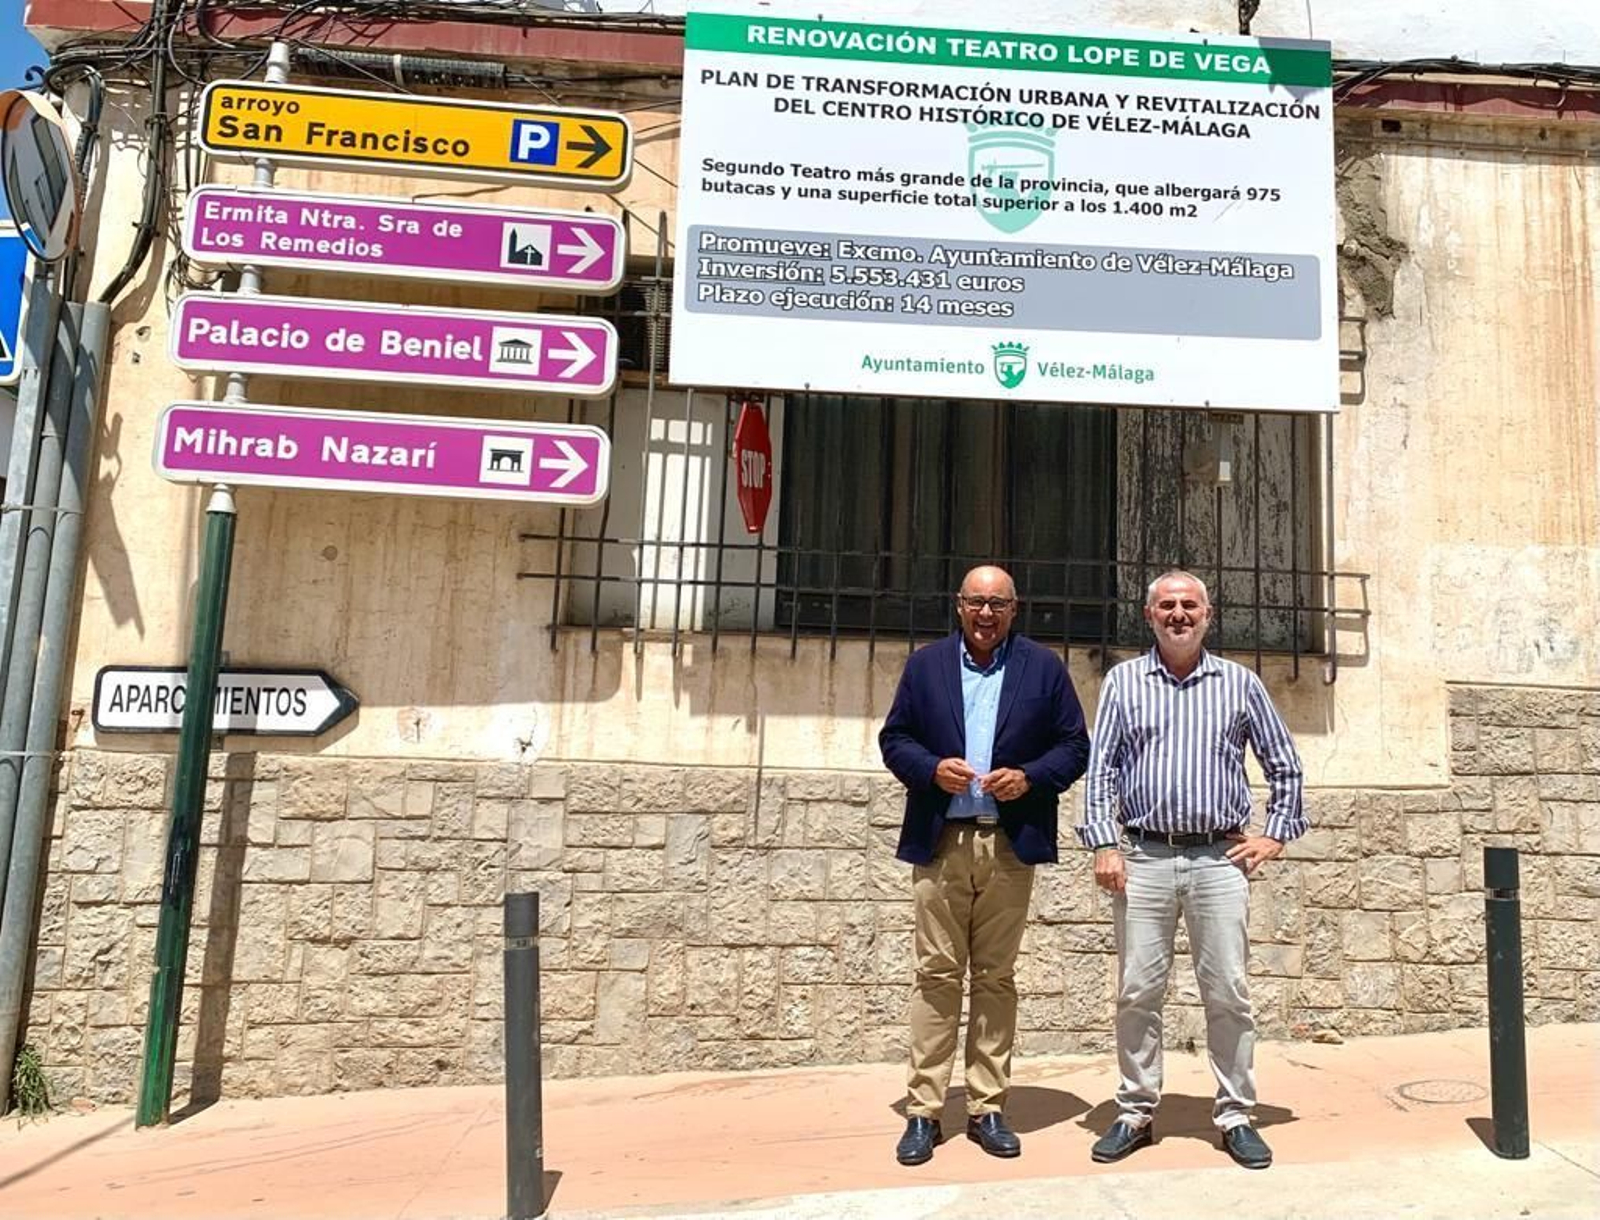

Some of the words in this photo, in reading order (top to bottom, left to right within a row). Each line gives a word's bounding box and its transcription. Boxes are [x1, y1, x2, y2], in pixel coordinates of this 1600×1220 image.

[747, 25, 936, 55] RENOVACIÓN
[946, 37, 1058, 62] TEATRO
[1067, 45, 1139, 66] LOPE
[1149, 50, 1185, 69] DE
[1194, 53, 1271, 74] VEGA
[220, 95, 301, 116] arroyo
[700, 69, 758, 88] PLAN
[766, 74, 795, 90] DE
[802, 75, 1011, 103] TRANSFORMACIÓN
[1019, 89, 1109, 108] URBANA
[1116, 94, 1130, 109] Y
[1136, 95, 1320, 119] REVITALIZACIÓN
[216, 115, 284, 144] San
[305, 121, 471, 158] Francisco
[773, 98, 816, 115] DEL
[822, 101, 912, 120] CENTRO
[919, 105, 1045, 127] HISTÓRICO
[1053, 114, 1080, 130] DE
[1087, 112, 1251, 139] VÉLEZ-MÁLAGA
[702, 158, 785, 177] Segundo
[790, 163, 851, 180] Teatro
[857, 166, 895, 183] más
[900, 172, 965, 188] grande
[970, 173, 993, 188] de
[999, 174, 1014, 189] la
[1020, 177, 1109, 196] provincia,
[1115, 183, 1149, 197] que
[1155, 182, 1241, 203] albergará
[1247, 186, 1282, 202] 975
[702, 178, 775, 196] butacas
[780, 185, 792, 200] y
[797, 186, 832, 200] una
[837, 188, 929, 206] superficie
[934, 191, 977, 207] total
[983, 197, 1059, 214] superior
[1063, 201, 1075, 212] a
[1081, 199, 1107, 213] los
[1113, 201, 1164, 217] 1.400
[1169, 203, 1198, 218] m2
[204, 201, 289, 226] Ermita
[300, 207, 366, 231] Ntra.
[377, 213, 420, 236] Sra
[432, 216, 464, 238] de
[200, 227, 245, 249] Los
[260, 231, 385, 258] Remedios
[699, 233, 832, 260] Promueve:
[837, 241, 924, 263] Excmo.
[930, 247, 1097, 272] Ayuntamiento
[1102, 253, 1132, 272] de
[1137, 252, 1295, 282] Vélez-Málaga
[698, 258, 825, 285] Inversión:
[830, 267, 951, 289] 5.553.431
[956, 274, 1025, 293] euros
[698, 284, 764, 305] Plazo
[770, 289, 895, 312] ejecución:
[901, 295, 931, 313] 14
[937, 300, 1014, 318] meses
[187, 317, 310, 350] Palacio
[325, 327, 365, 353] de
[380, 331, 484, 361] Beniel
[861, 354, 985, 376] Ayuntamiento
[1037, 361, 1155, 384] Vélez-Málaga
[172, 428, 299, 460] Mihrab
[321, 436, 438, 469] Nazarí
[742, 449, 766, 488] STOP
[109, 684, 307, 716] APARCIENTOS
